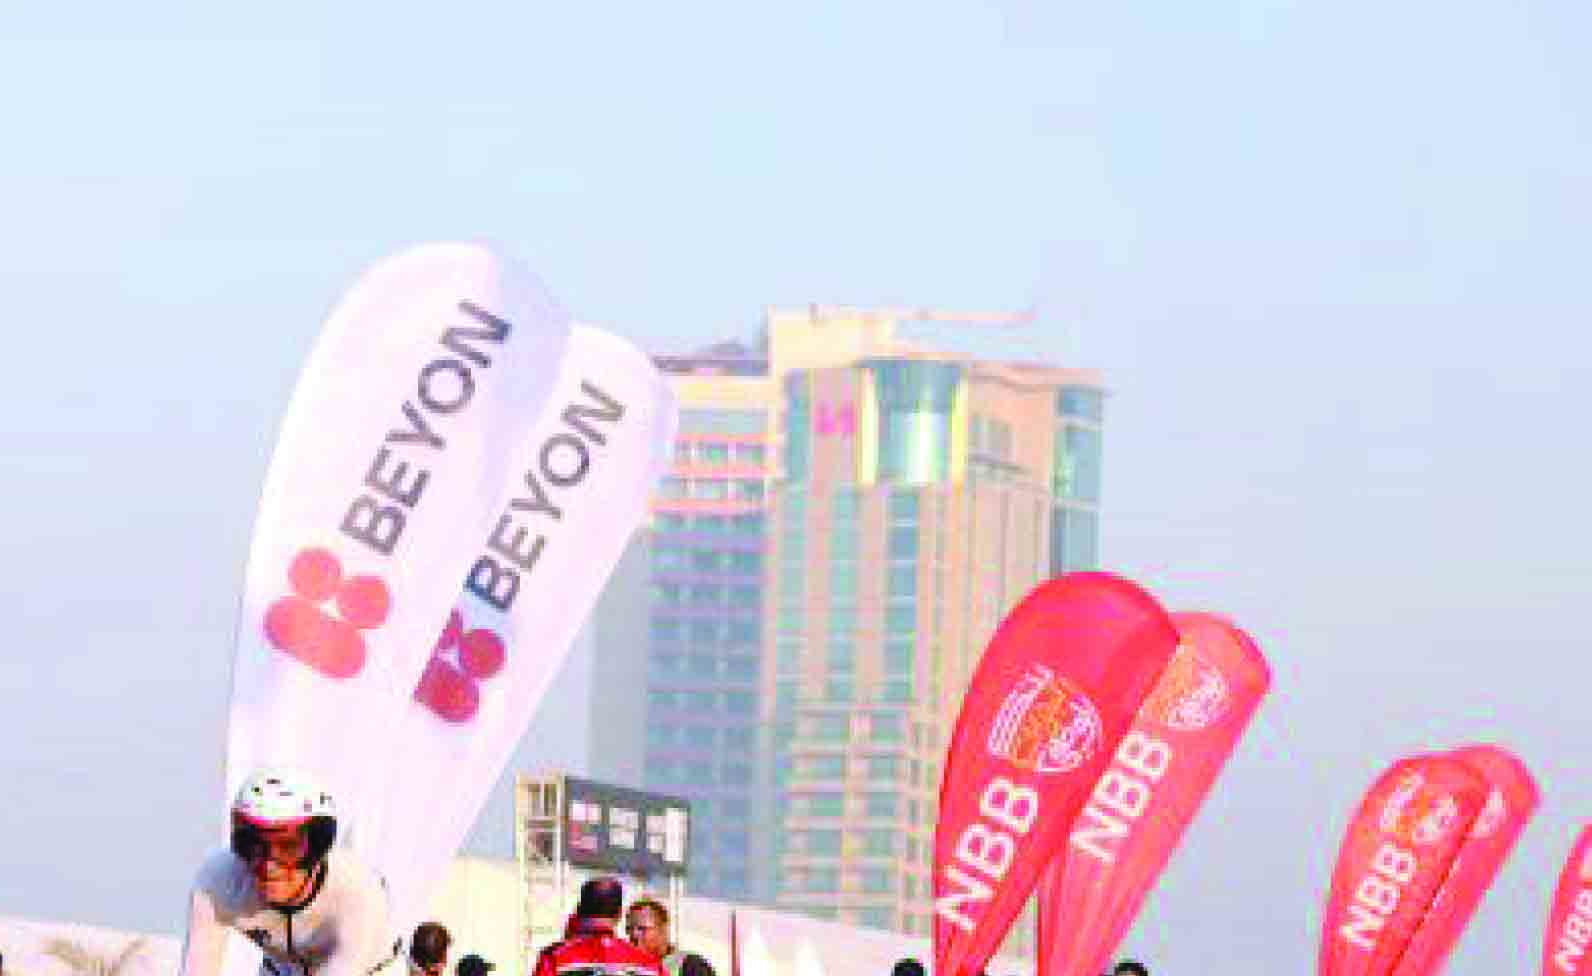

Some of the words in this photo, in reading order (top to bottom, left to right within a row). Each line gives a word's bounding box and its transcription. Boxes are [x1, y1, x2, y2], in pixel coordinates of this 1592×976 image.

[339, 298, 512, 556] BEYON
[463, 379, 627, 614] BEYON
[934, 777, 1039, 934] NBB
[1070, 730, 1173, 865] NBB
[1339, 841, 1416, 952] NBB
